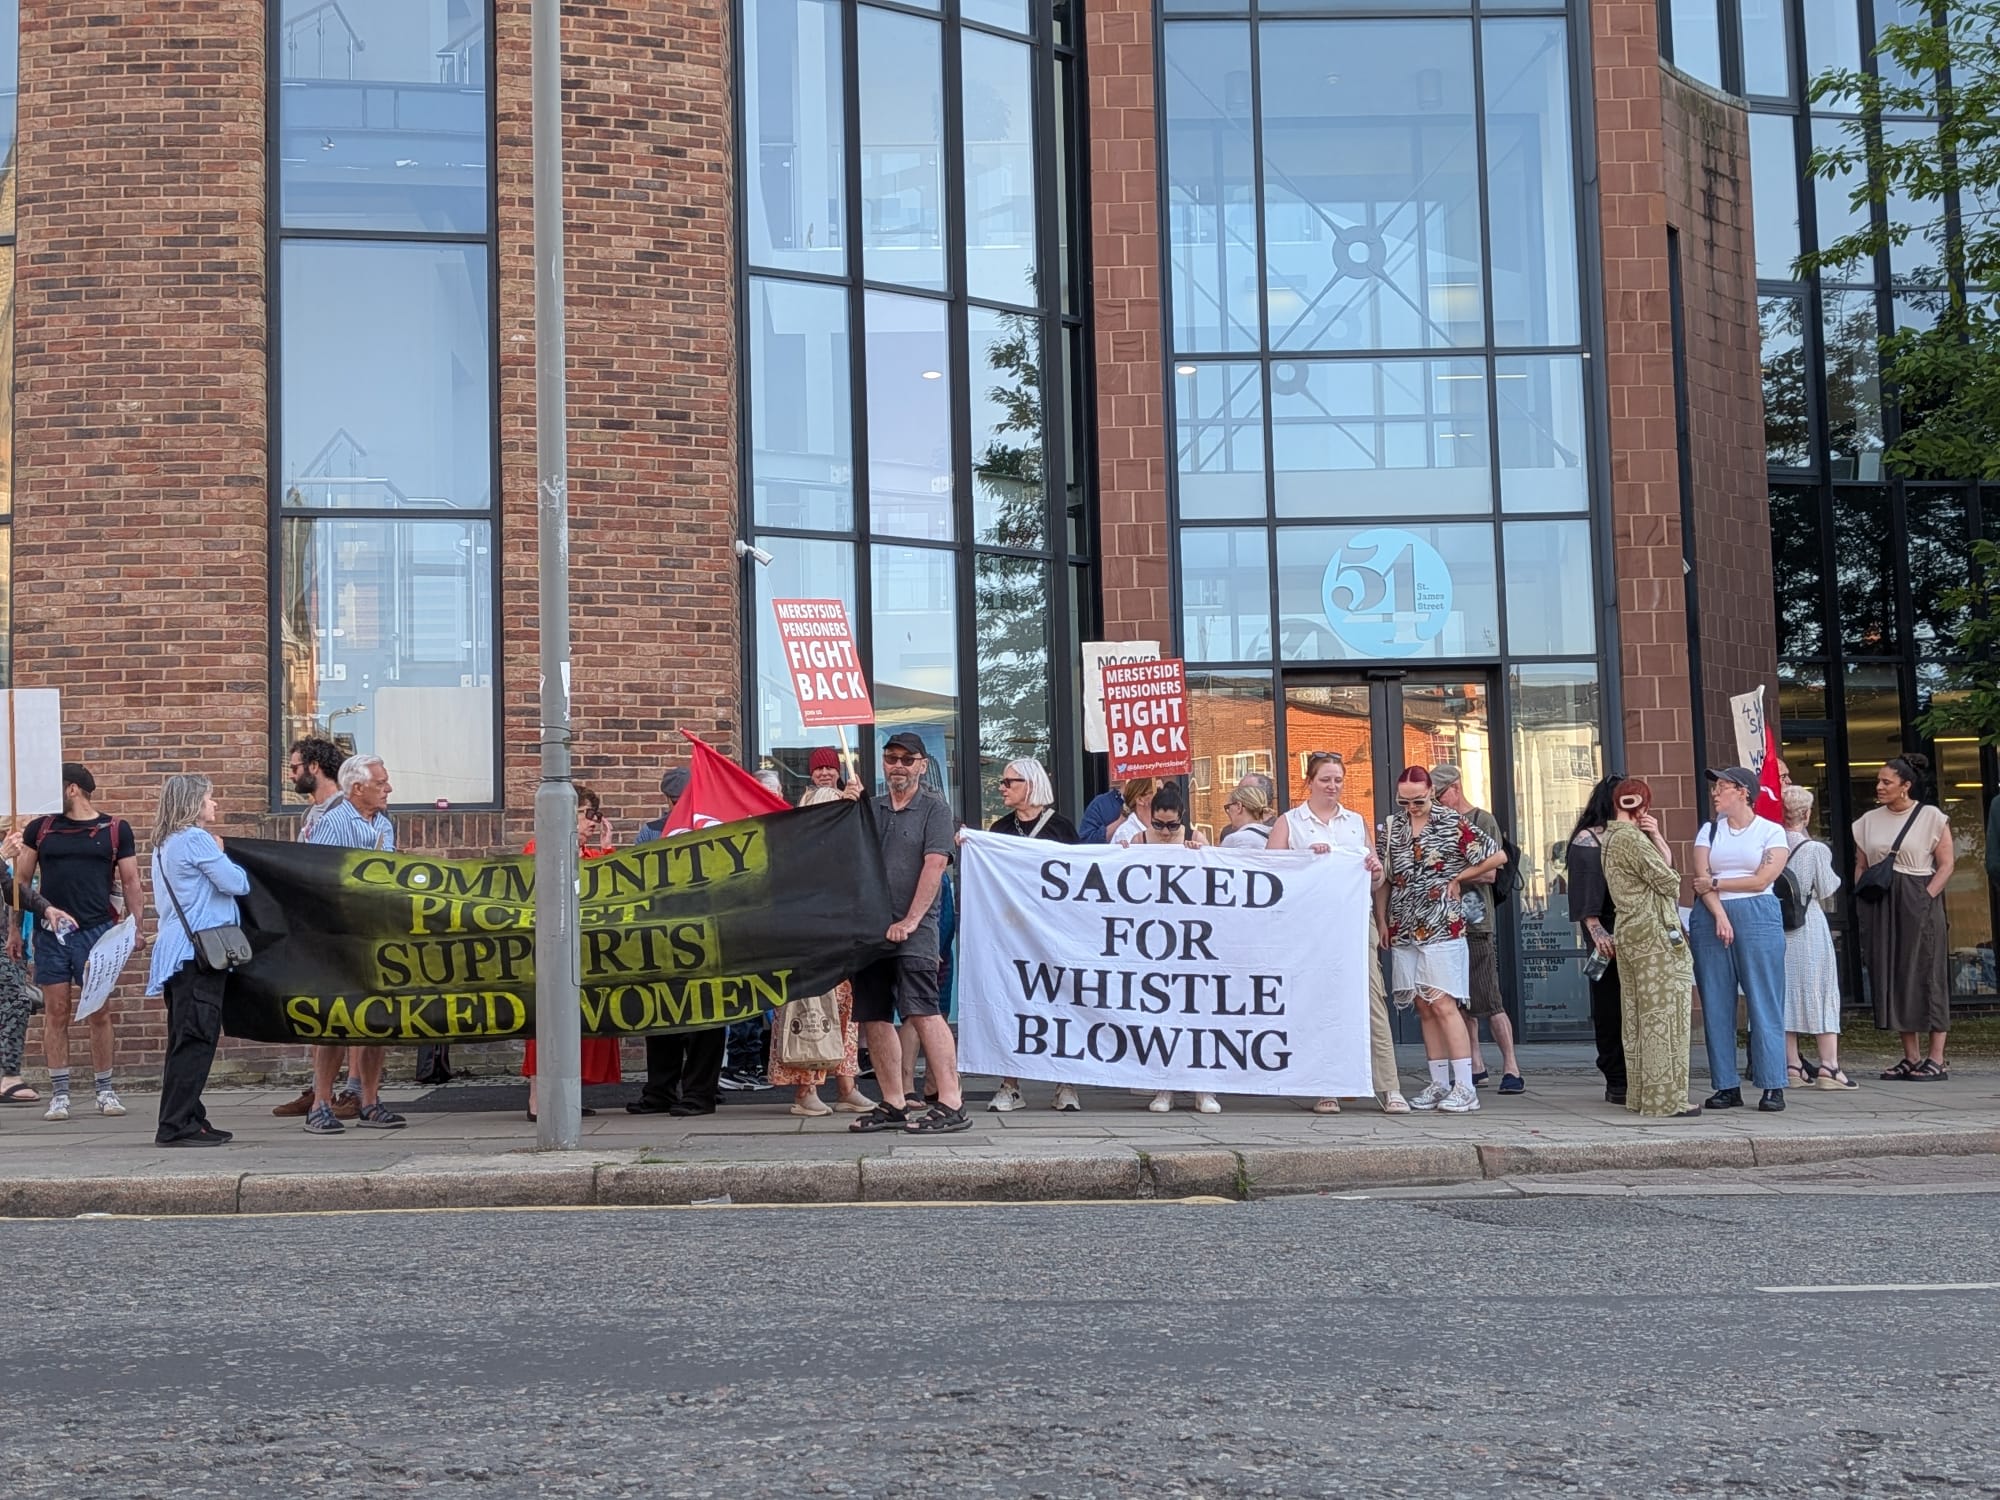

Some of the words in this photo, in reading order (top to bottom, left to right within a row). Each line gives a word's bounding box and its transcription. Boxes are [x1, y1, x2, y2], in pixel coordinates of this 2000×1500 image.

[777, 603, 843, 619] MERSEYSIDE
[1417, 592, 1445, 601] James
[1418, 602, 1445, 610] Street
[782, 622, 848, 637] PENSIONERS
[788, 640, 854, 669] FIGHT
[796, 671, 866, 701] BACK
[1106, 664, 1180, 684] MERSEYSIDE
[1107, 681, 1182, 700] PENSIONERS
[1110, 697, 1183, 729] FIGHT
[1112, 726, 1188, 758] BACK
[1040, 859, 1284, 908] SACKED
[1100, 916, 1219, 962] FOR
[376, 923, 706, 987] SUPPRTS
[1013, 959, 1286, 1016] WHISTLE
[286, 991, 527, 1038] SACKED
[1013, 1013, 1293, 1072] BLOWING
